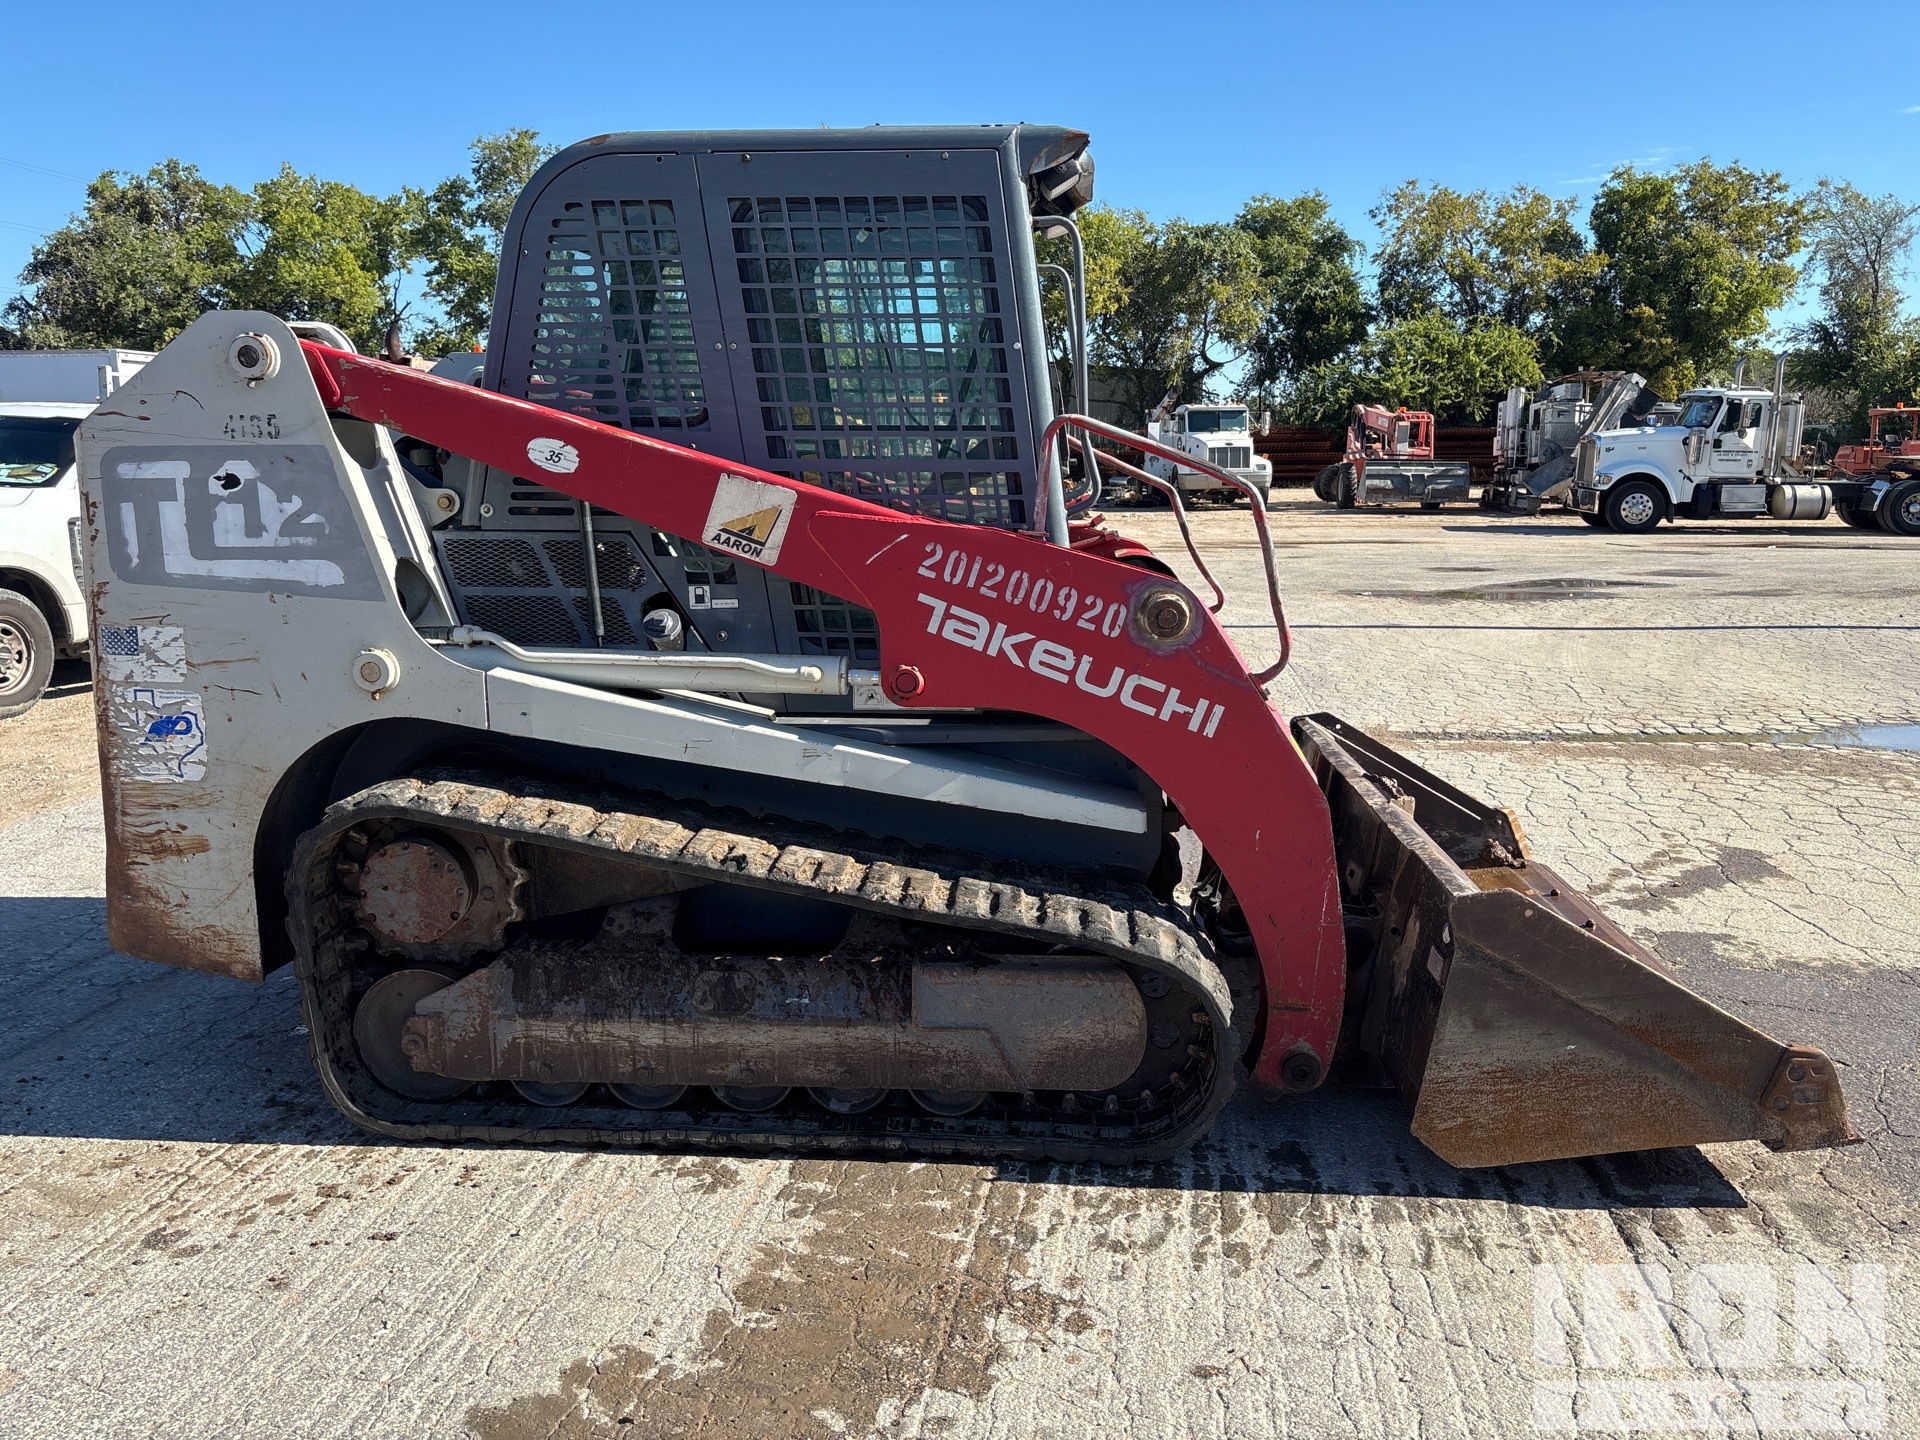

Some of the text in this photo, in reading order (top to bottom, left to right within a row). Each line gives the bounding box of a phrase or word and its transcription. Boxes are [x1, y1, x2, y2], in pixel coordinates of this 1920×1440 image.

[545, 450, 564, 464] 35
[710, 531, 765, 559] AARON
[916, 541, 1128, 638] 201200920
